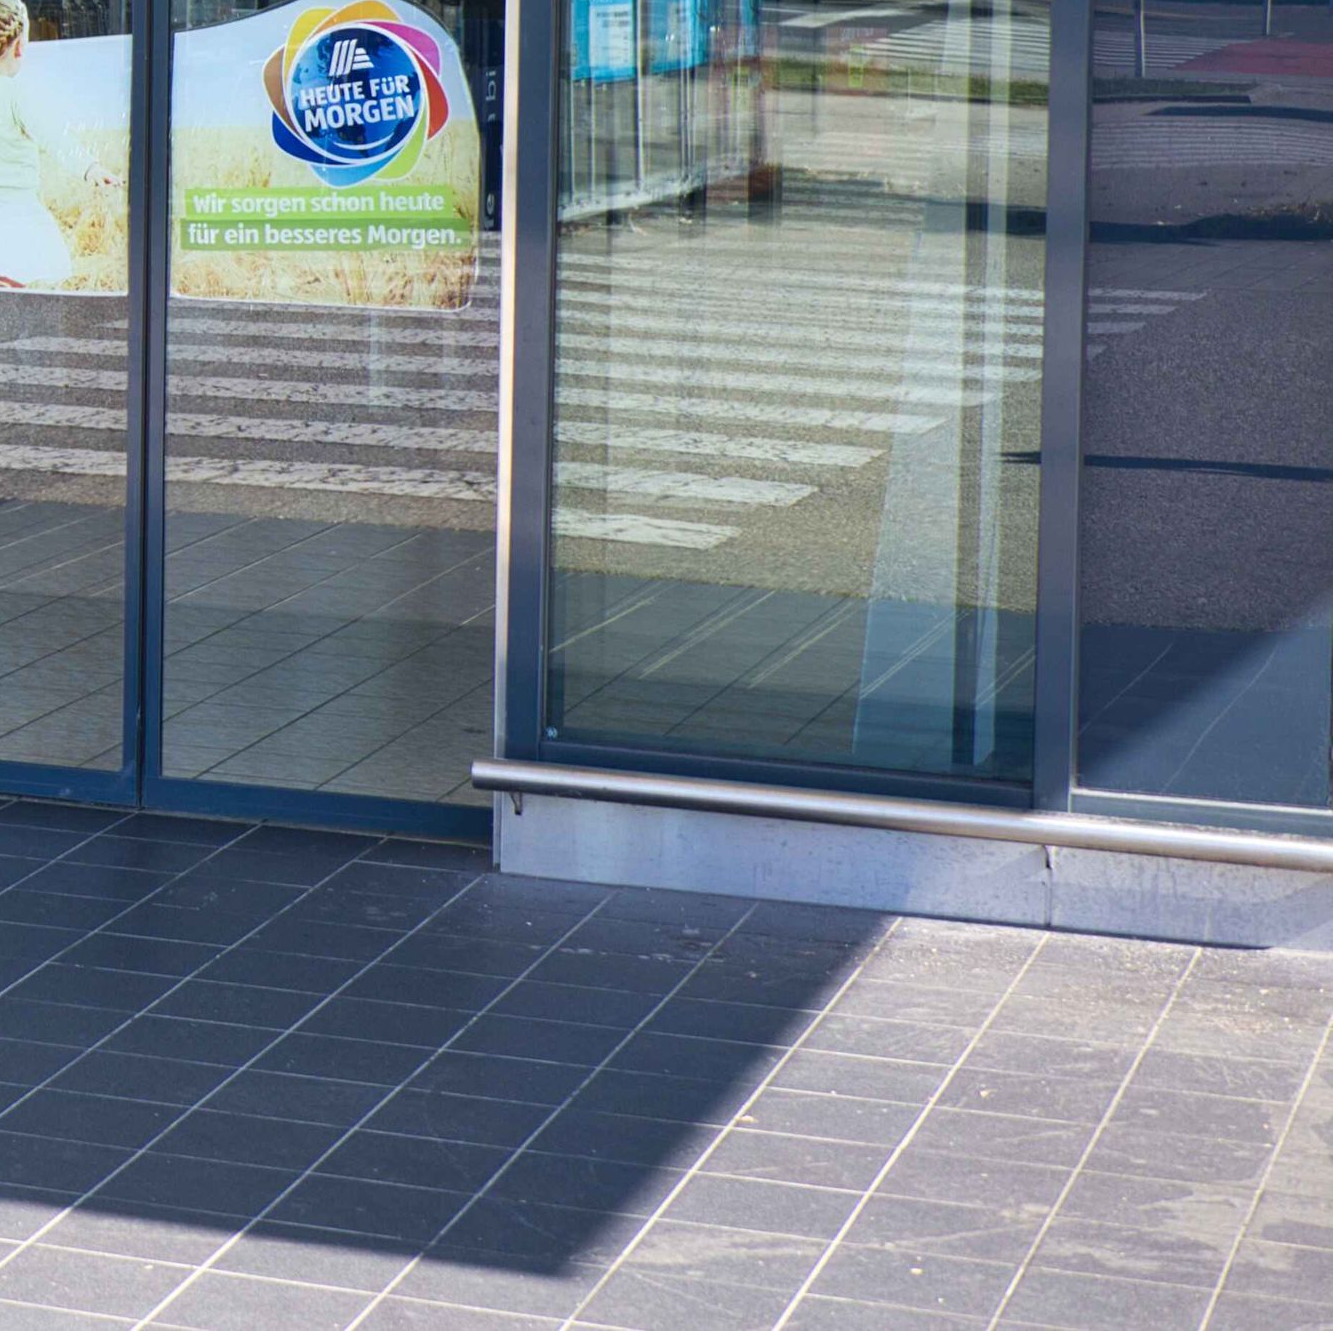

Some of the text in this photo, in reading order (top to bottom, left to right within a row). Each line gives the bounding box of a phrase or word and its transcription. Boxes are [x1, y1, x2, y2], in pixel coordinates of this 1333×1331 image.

[299, 74, 410, 110] HEUTE FÜR
[305, 95, 415, 133] MORGEN
[193, 191, 445, 217] Wir sorgen schon heute
[188, 223, 462, 250] für ein besseres Morgen.
